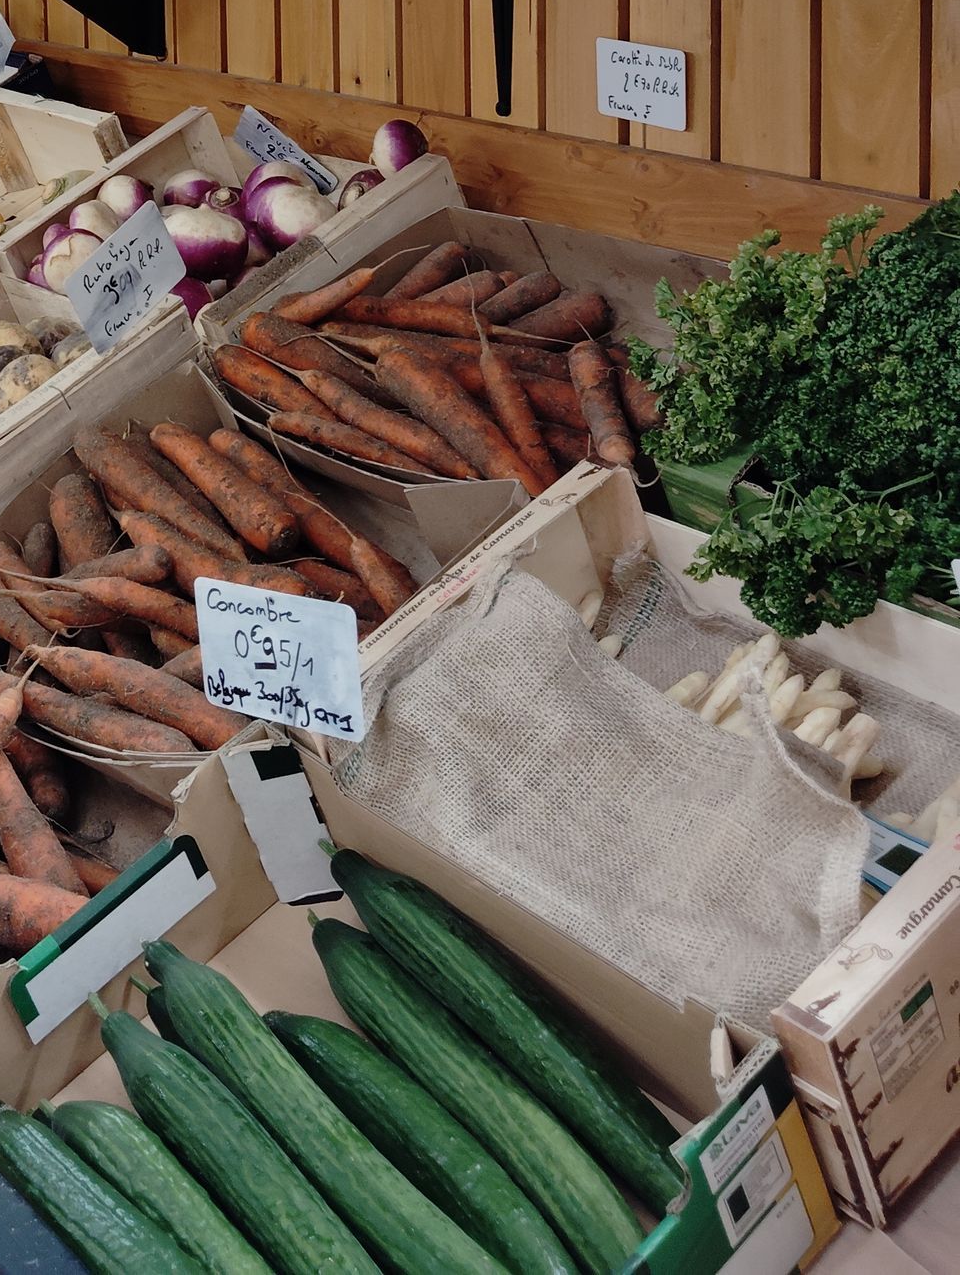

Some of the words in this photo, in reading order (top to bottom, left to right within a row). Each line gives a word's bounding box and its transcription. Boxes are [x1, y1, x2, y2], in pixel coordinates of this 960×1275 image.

[469, 551, 482, 563] de
[482, 510, 535, 551] Camargue
[207, 587, 301, 623] Concombre
